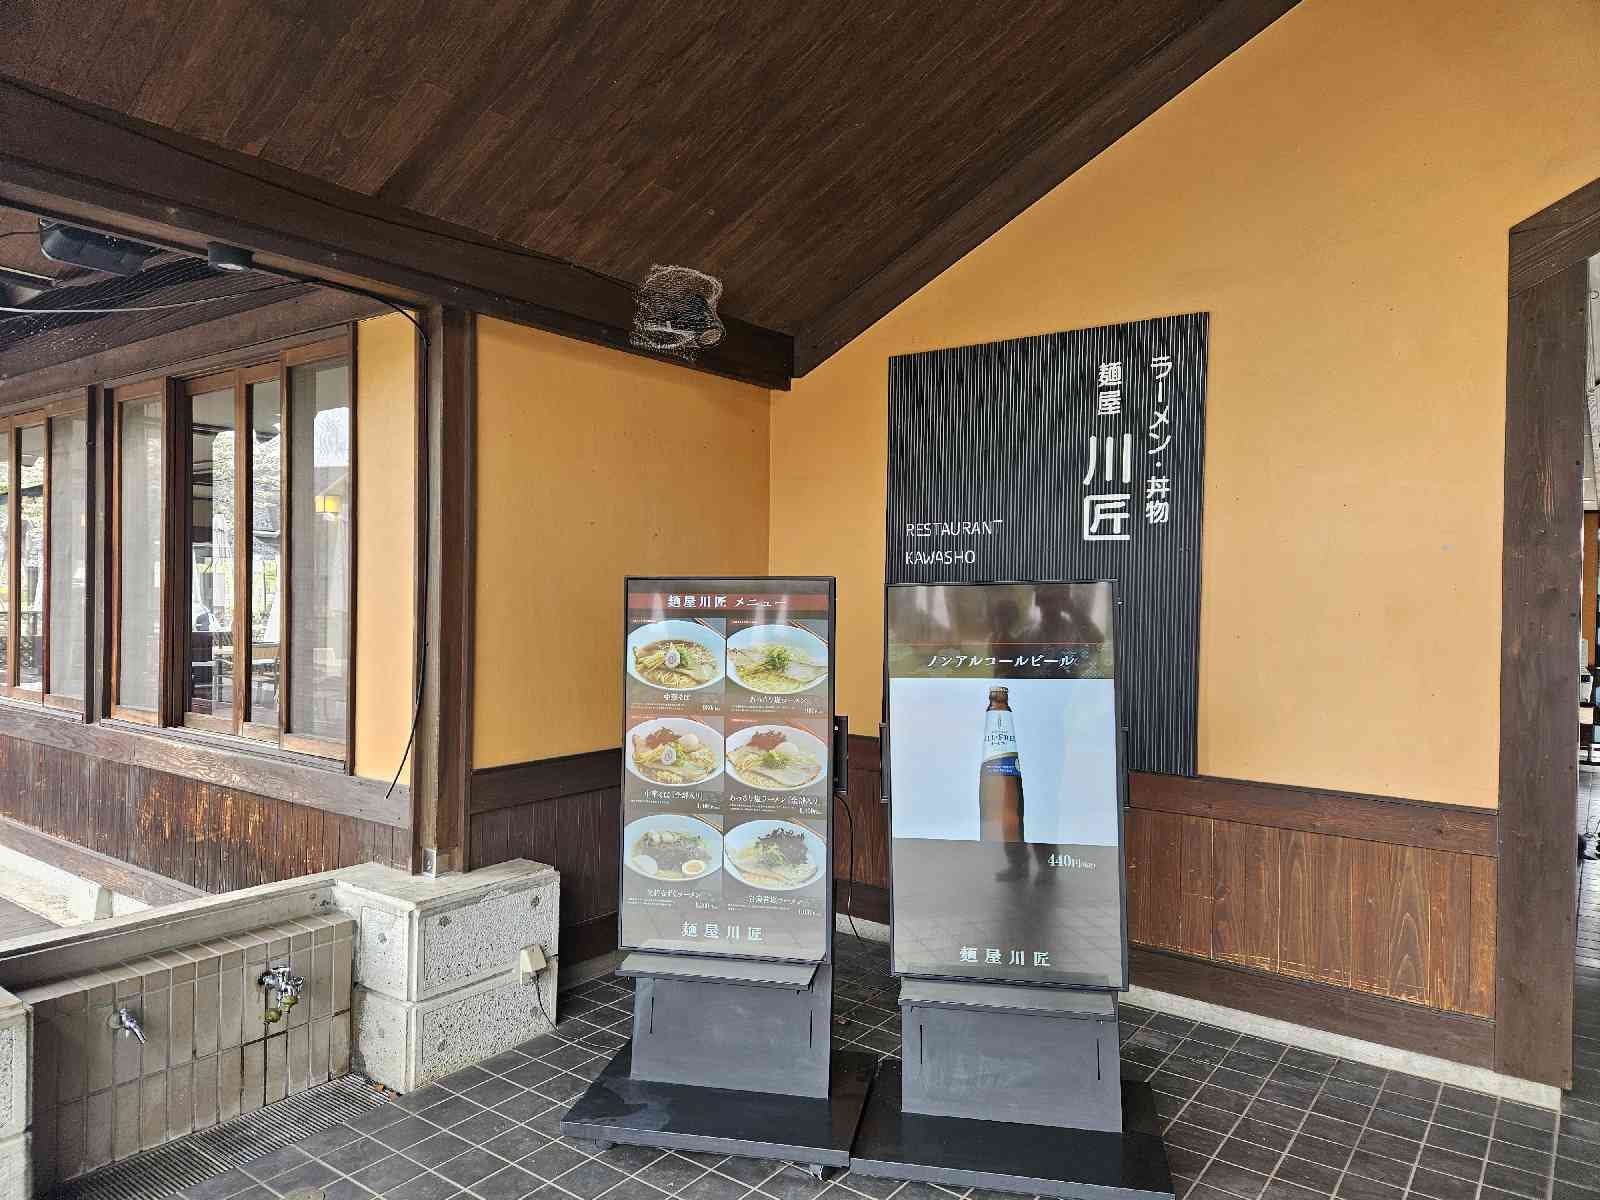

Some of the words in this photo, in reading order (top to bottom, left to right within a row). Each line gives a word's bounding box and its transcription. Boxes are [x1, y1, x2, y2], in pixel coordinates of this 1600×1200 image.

[906, 520, 1003, 537] RESTAURANT
[905, 550, 976, 565] KAWASHO
[927, 654, 1076, 668] ノンアルコールビール
[960, 945, 1051, 967] 麺屋川匠
